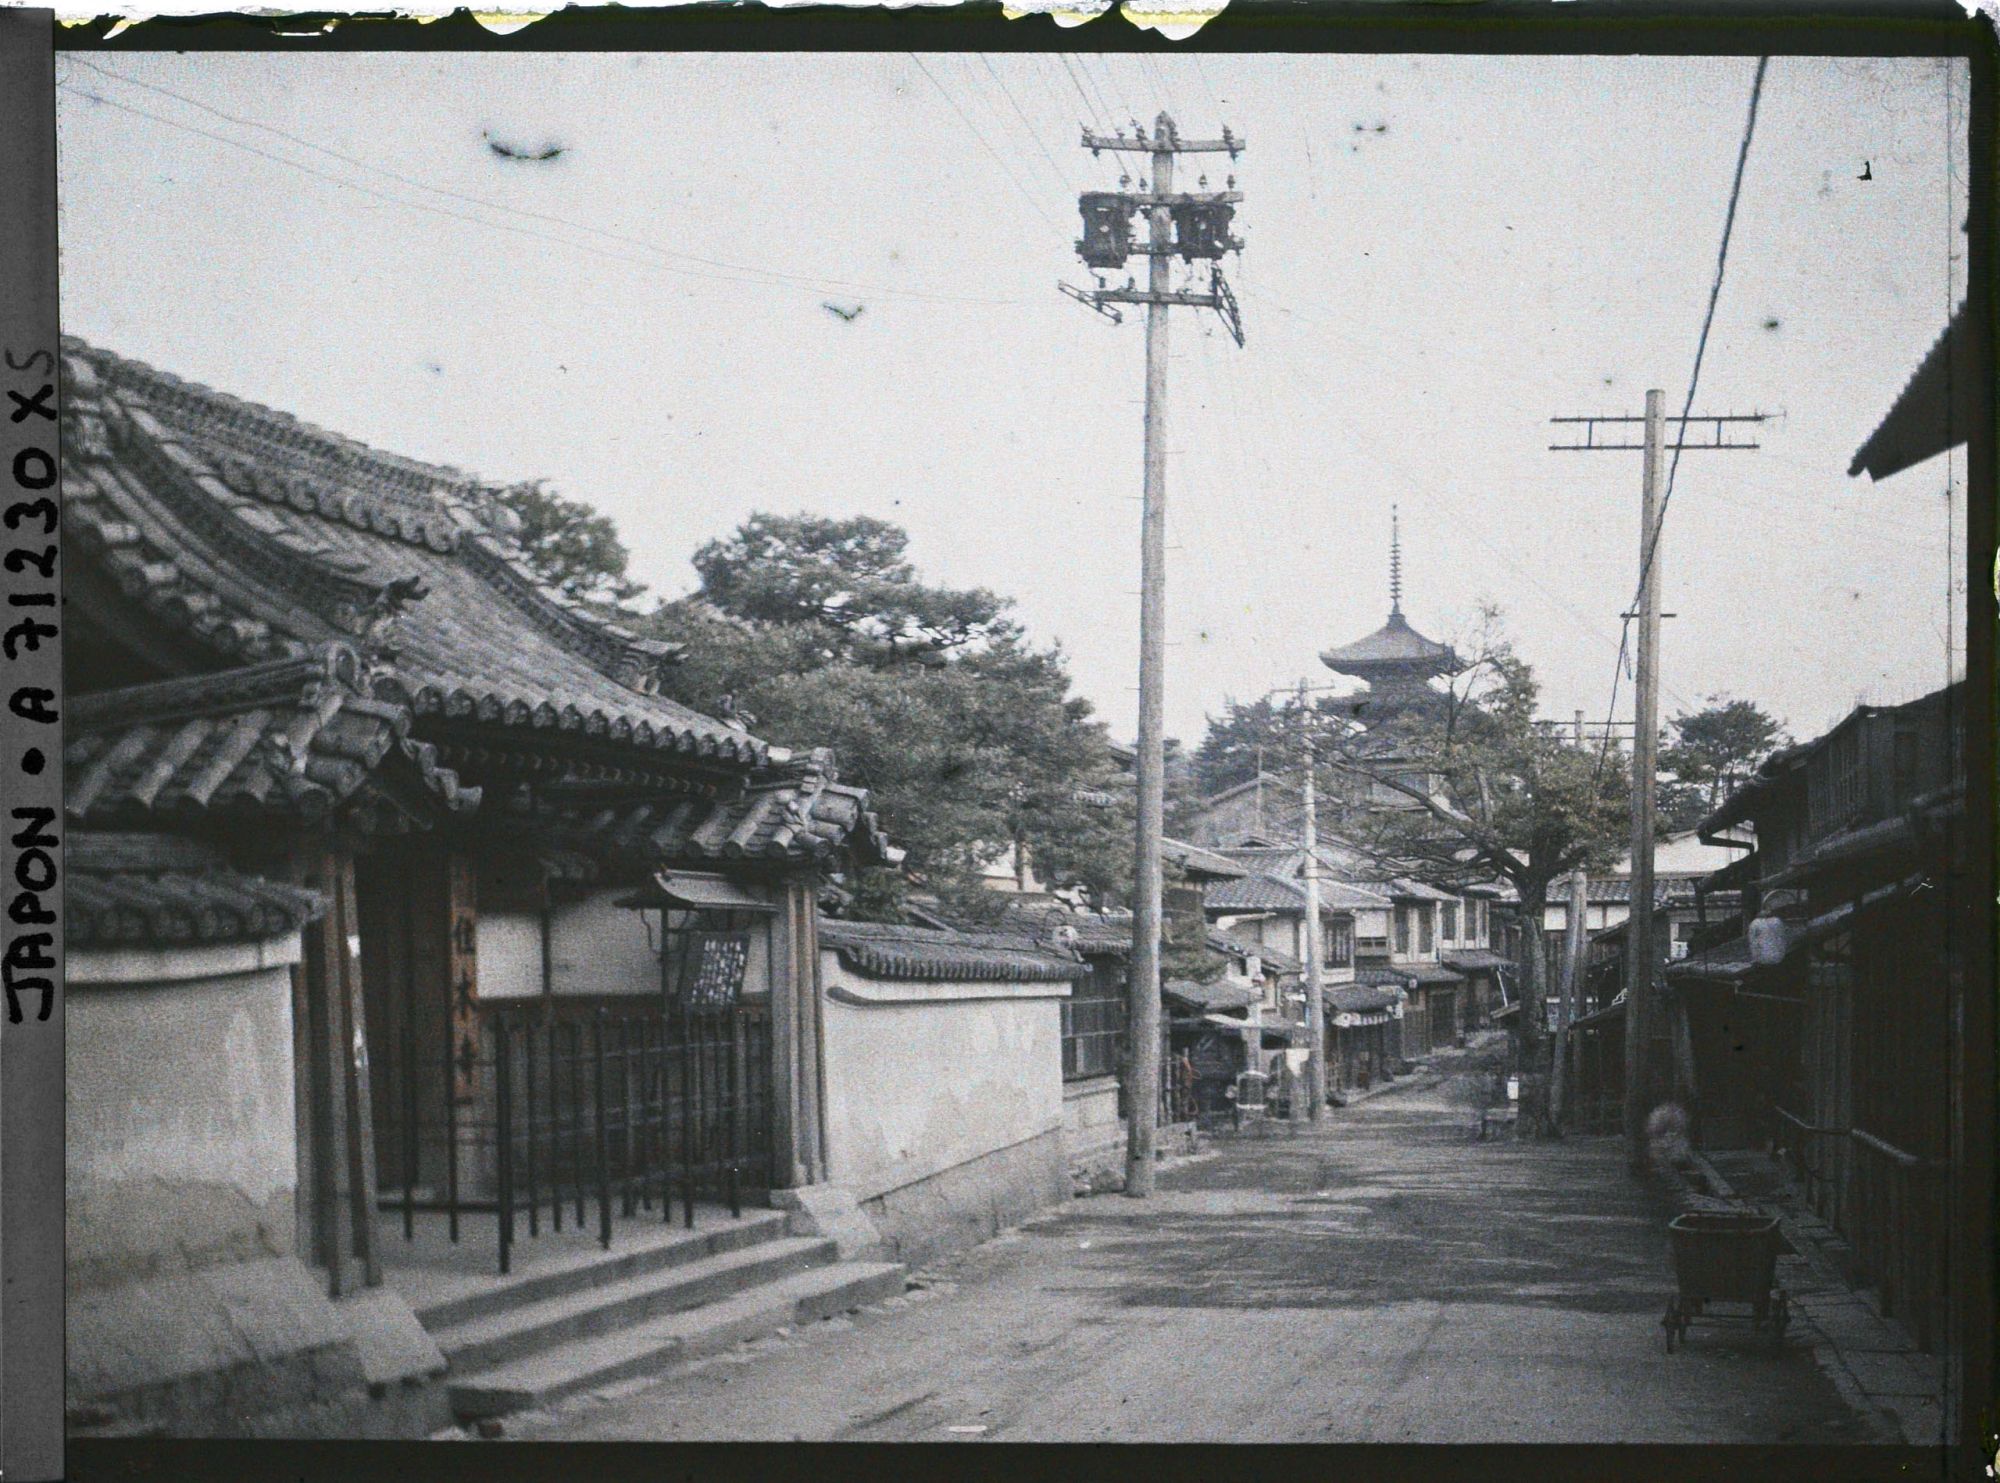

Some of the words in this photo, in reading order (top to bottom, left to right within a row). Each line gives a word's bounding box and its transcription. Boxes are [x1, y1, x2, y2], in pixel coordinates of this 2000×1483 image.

[3, 446, 59, 661] 71230
[8, 686, 60, 725] A
[1, 806, 60, 1025] JAPON
